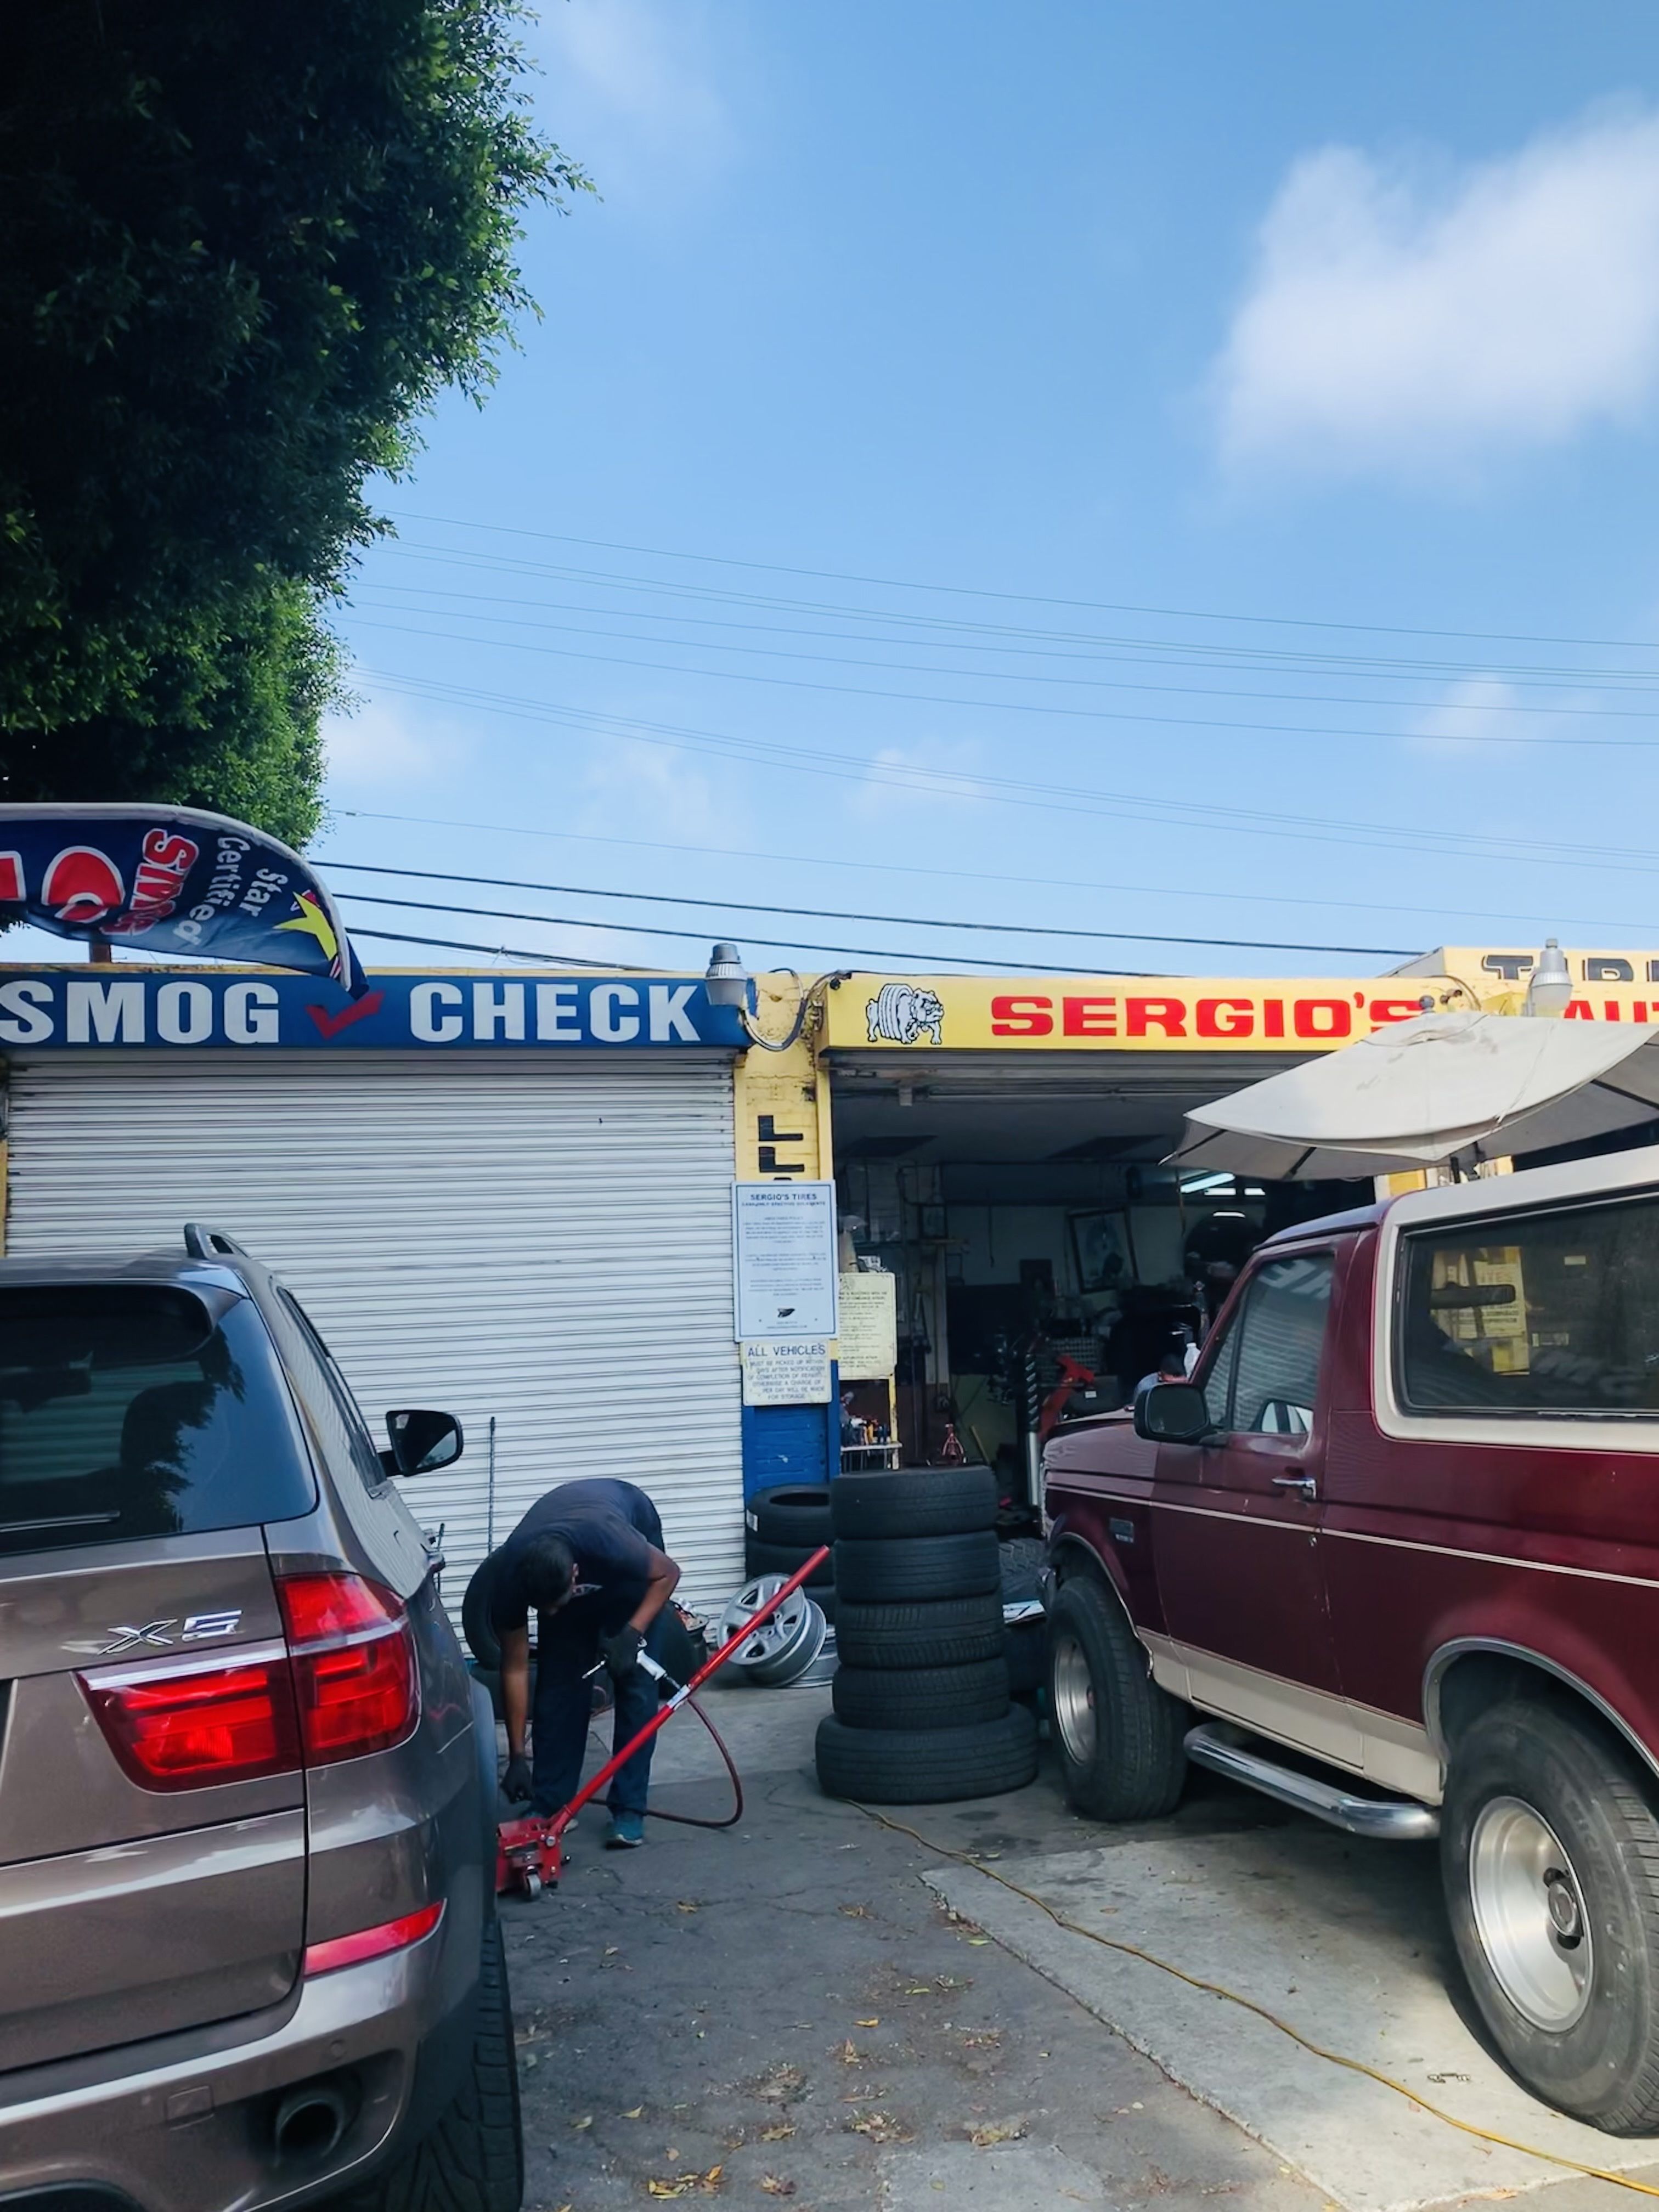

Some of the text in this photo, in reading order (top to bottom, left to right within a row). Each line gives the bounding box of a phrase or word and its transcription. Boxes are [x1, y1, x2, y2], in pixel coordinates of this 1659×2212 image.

[173, 837, 250, 946] Certified
[239, 868, 288, 917] Star
[0, 981, 701, 1044] SMOG CHECK
[991, 992, 1423, 1037] SERGIO'S
[748, 1345, 826, 1357] ALL VEHICLES
[97, 1610, 242, 1655] X5
